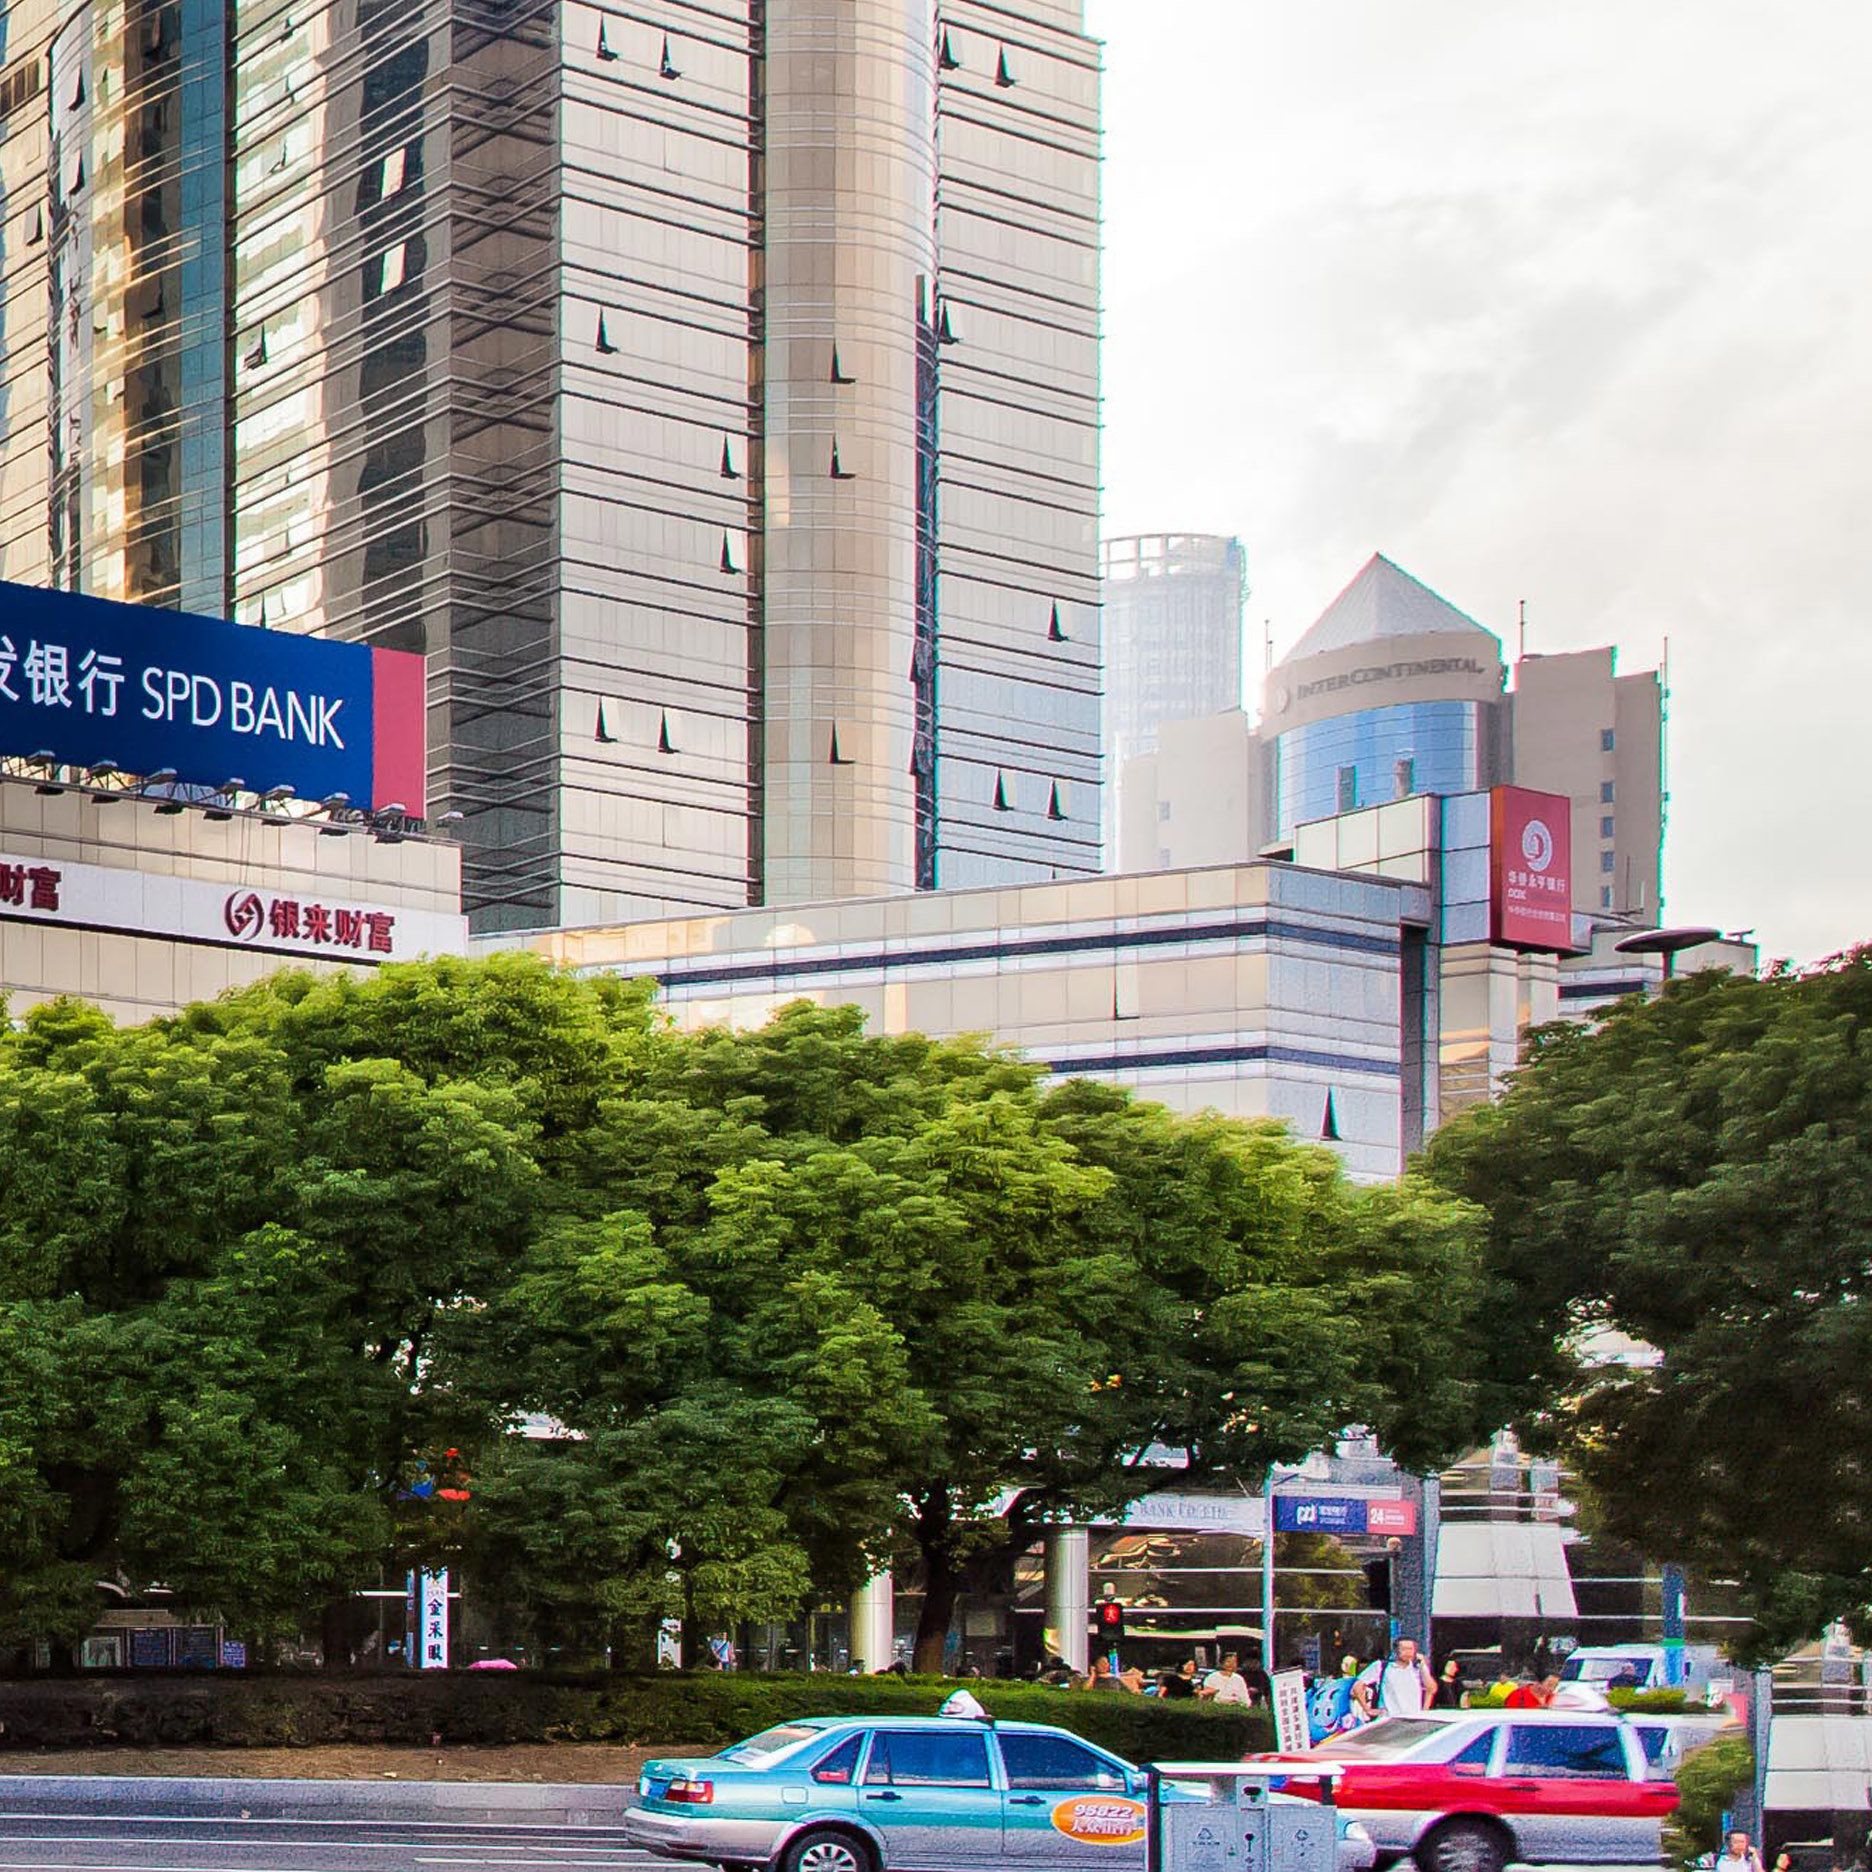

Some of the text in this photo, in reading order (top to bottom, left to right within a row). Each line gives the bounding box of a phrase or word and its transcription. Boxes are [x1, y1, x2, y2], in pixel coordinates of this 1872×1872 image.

[1297, 658, 1485, 700] INTERCONTINENTAL
[141, 666, 345, 750] SPD BANK
[269, 898, 395, 953] 银来财富
[1370, 1507, 1385, 1525] 24
